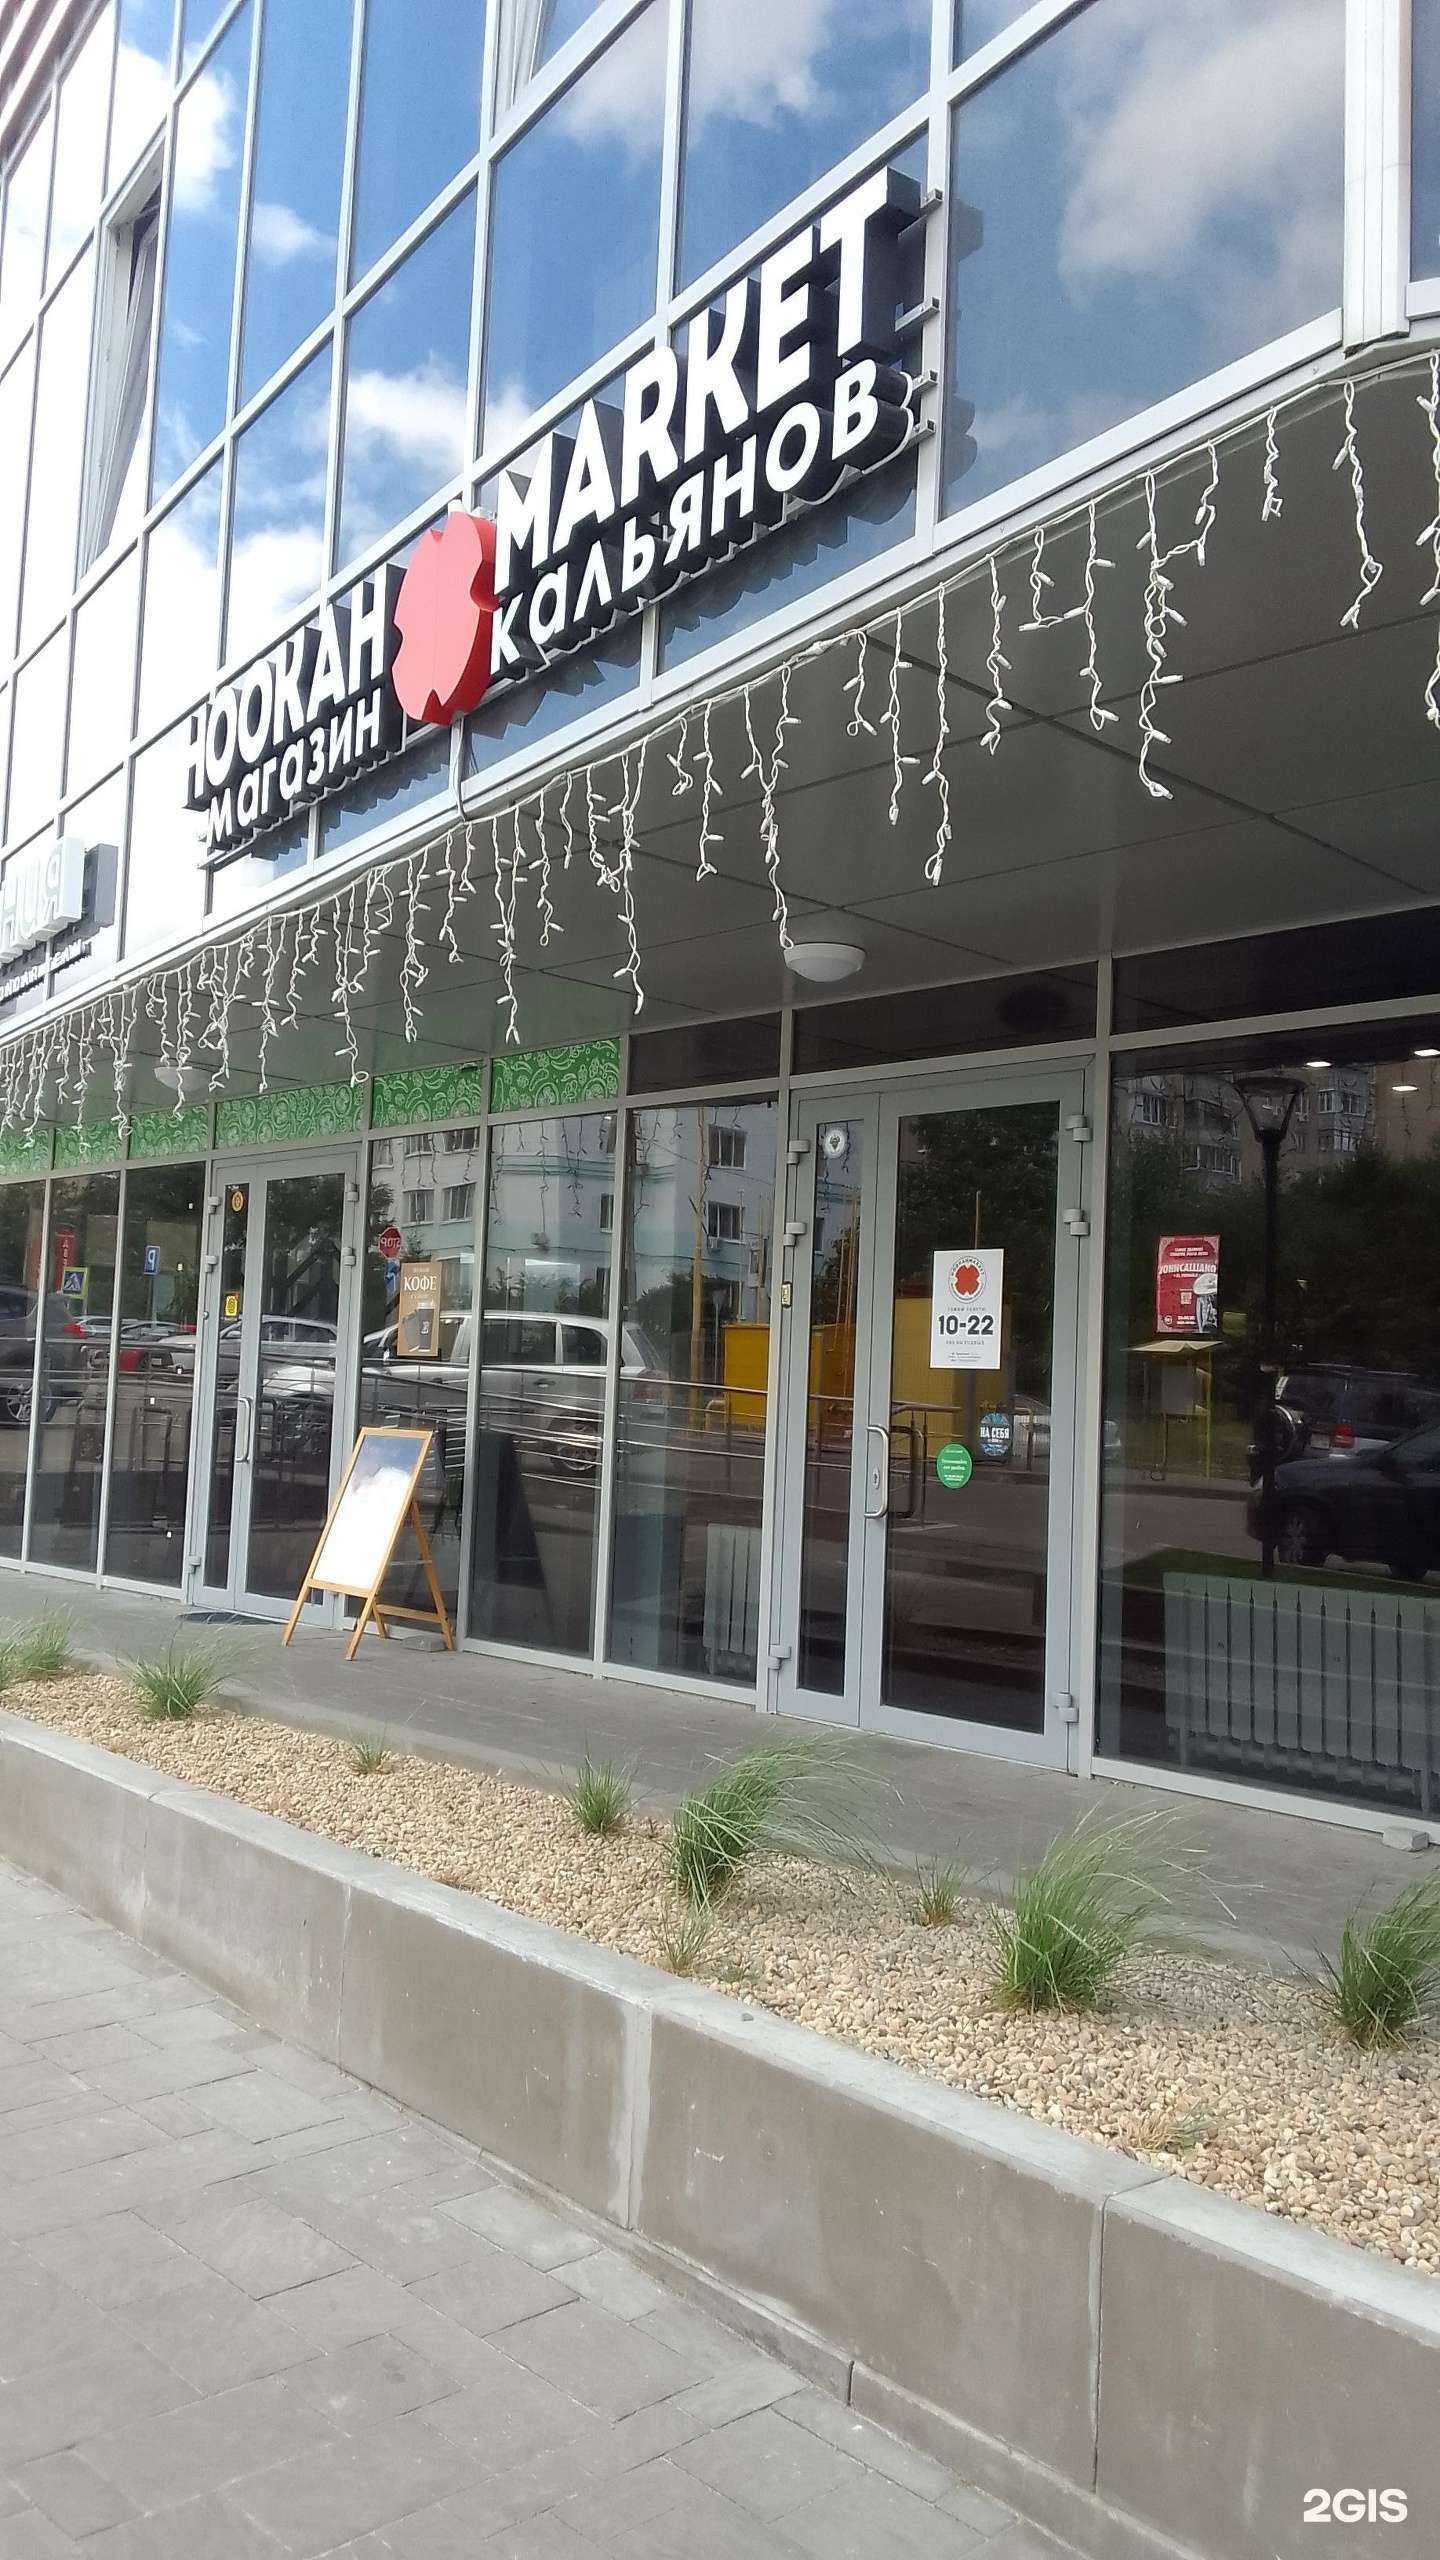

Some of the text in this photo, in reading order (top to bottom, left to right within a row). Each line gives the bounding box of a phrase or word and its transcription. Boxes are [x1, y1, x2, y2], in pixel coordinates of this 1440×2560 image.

[183, 166, 888, 806] HOOKAH MARKET
[206, 359, 878, 850] магазин кальянов
[404, 1275, 437, 1291] КОФЕ
[938, 1314, 994, 1336] 10-22
[991, 1427, 1010, 1439] СЕБЯ
